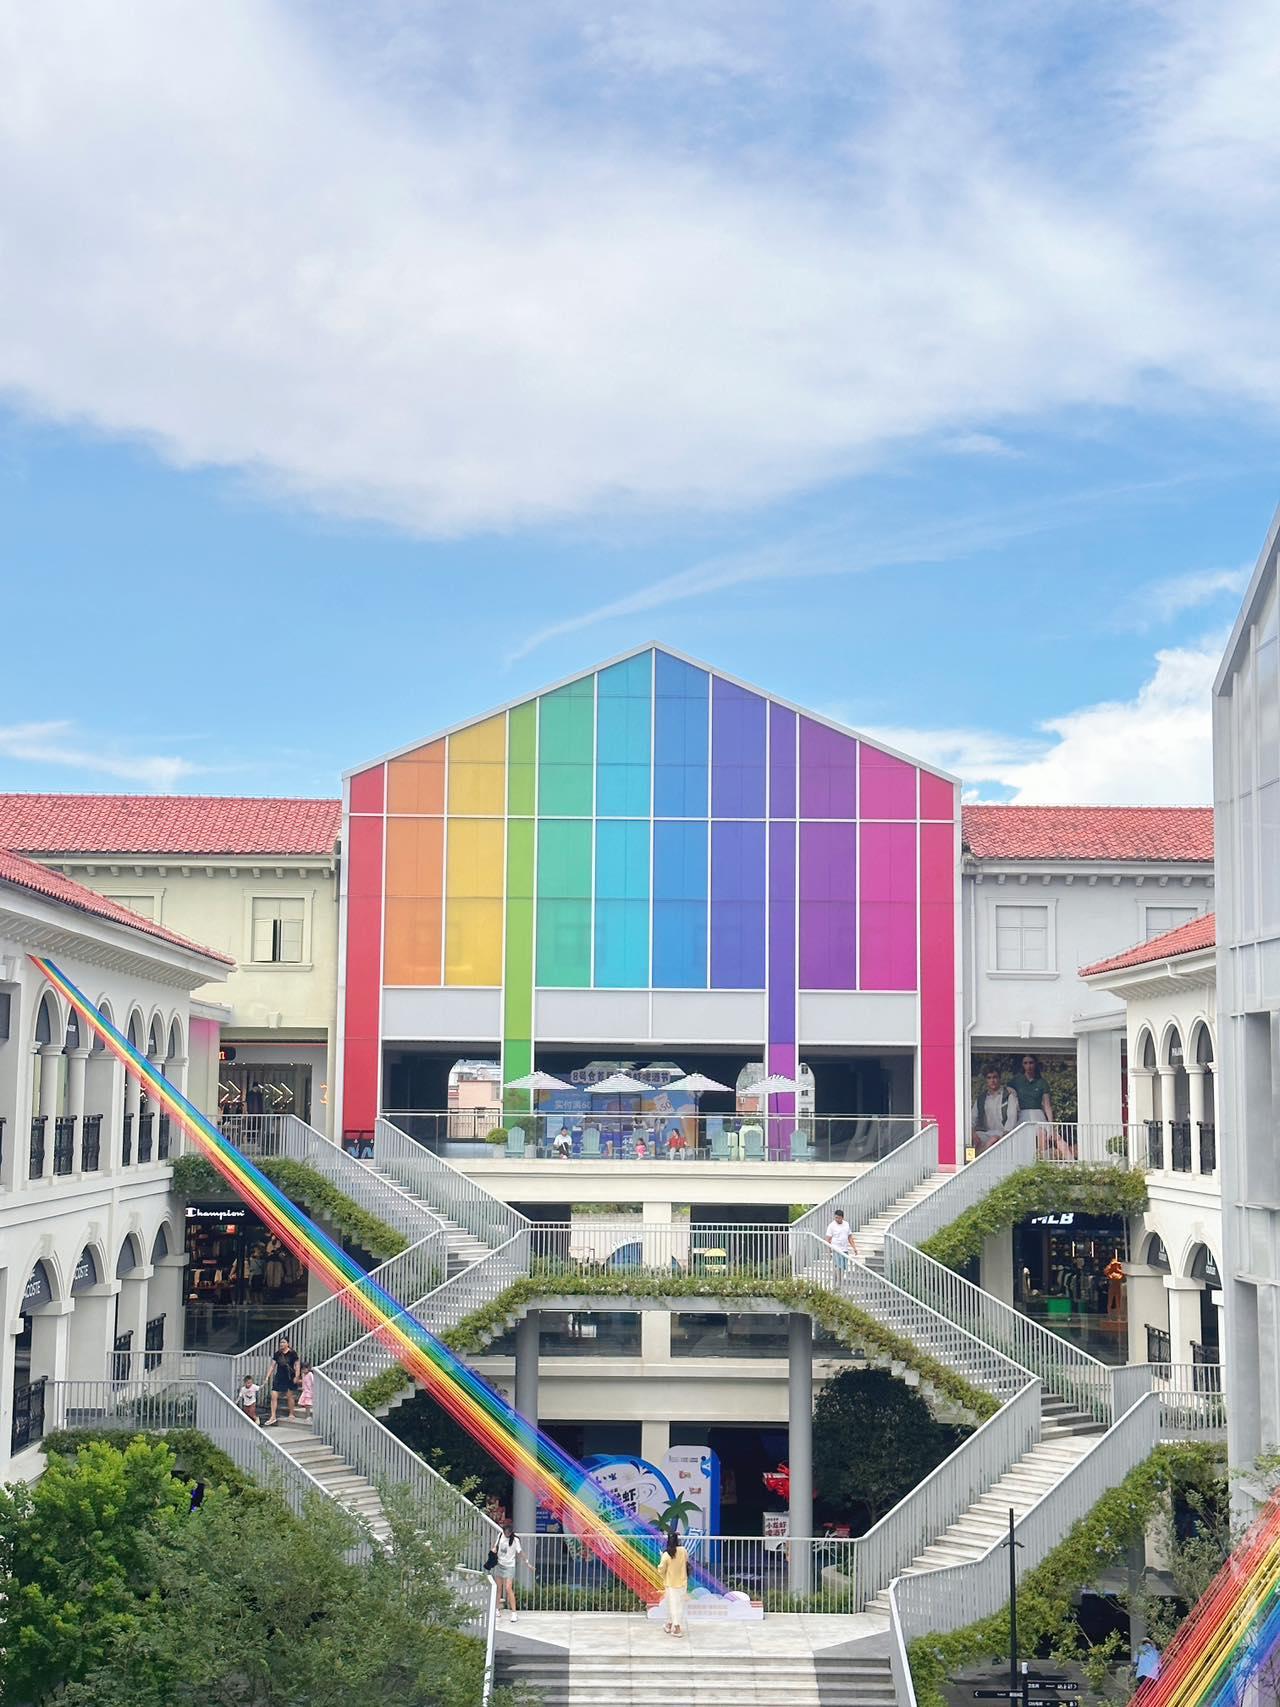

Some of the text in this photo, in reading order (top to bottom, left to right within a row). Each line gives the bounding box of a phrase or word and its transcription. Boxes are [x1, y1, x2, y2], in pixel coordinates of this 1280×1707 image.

[185, 1207, 246, 1221] Champion
[1031, 1212, 1074, 1225] MLB
[75, 1264, 89, 1280] COSTE
[24, 1280, 41, 1298] COSTE
